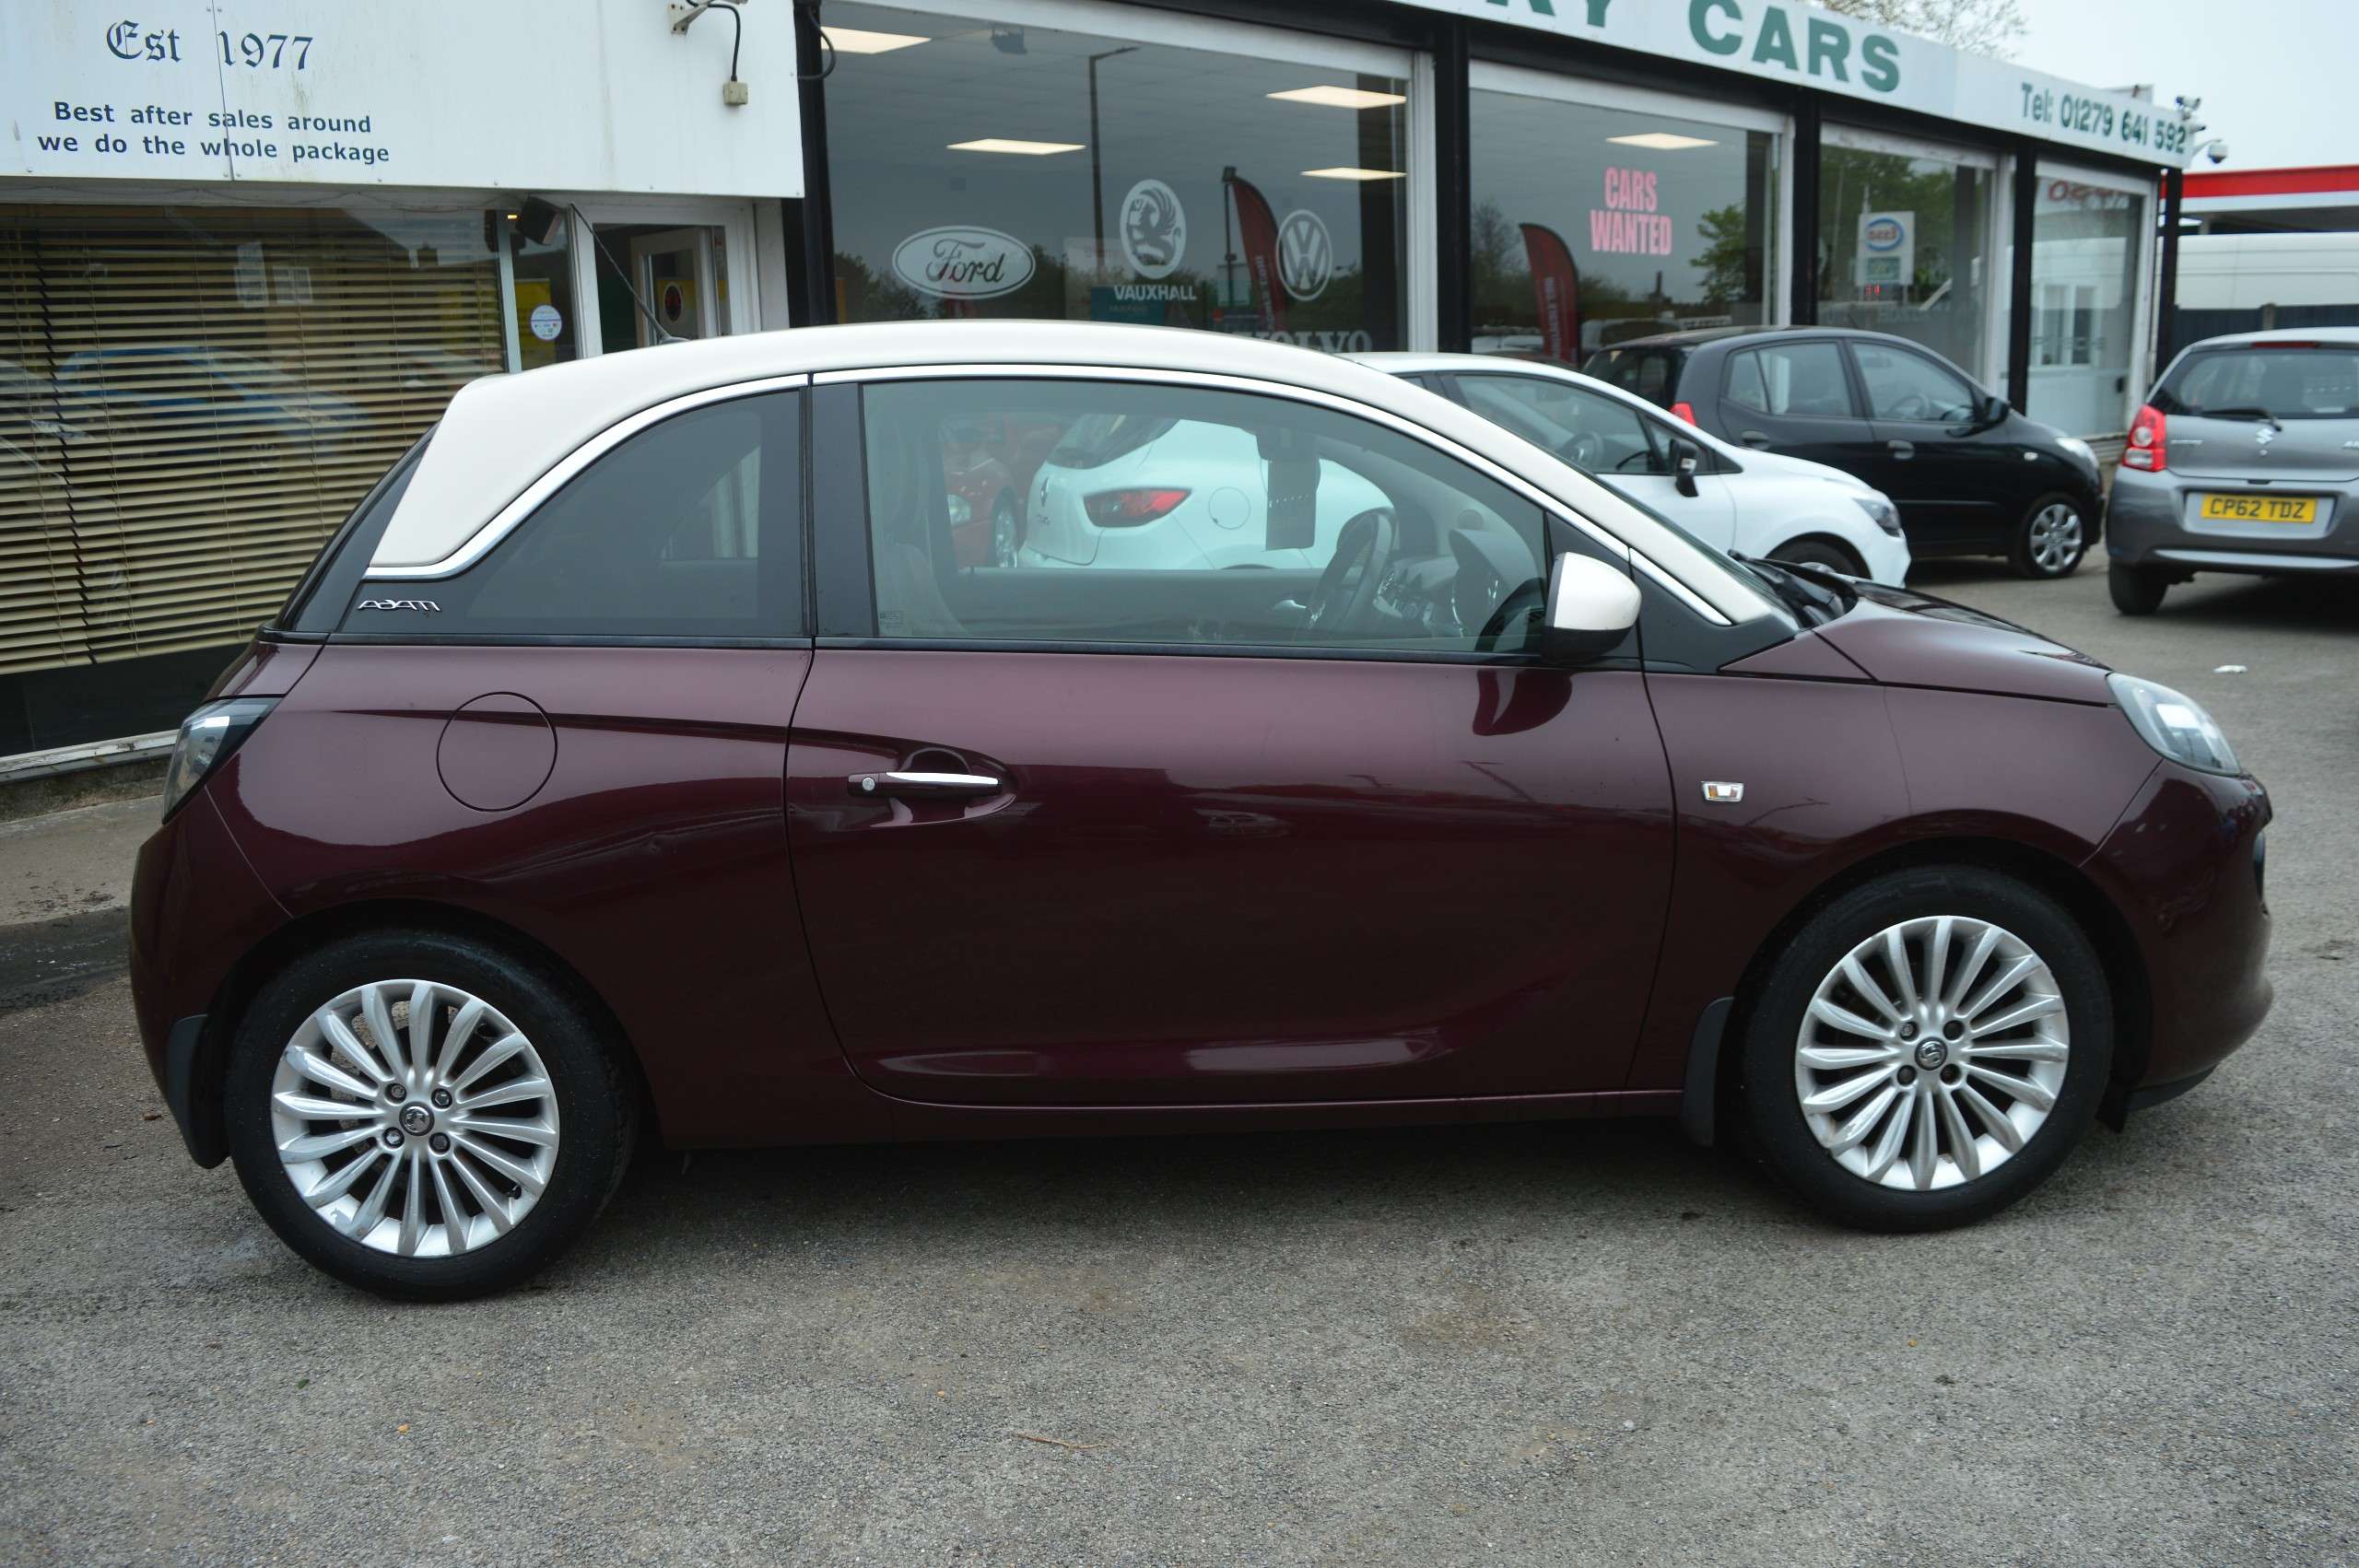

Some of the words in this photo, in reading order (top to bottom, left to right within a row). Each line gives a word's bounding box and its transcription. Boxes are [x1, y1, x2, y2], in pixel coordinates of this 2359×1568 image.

[106, 19, 182, 63] Est
[217, 30, 313, 70] 1977
[1689, 0, 1900, 93] CARS
[53, 101, 114, 123] Best
[130, 104, 193, 126] after
[208, 107, 273, 130] sales
[288, 113, 371, 134] around
[2022, 82, 2053, 123] Tel:
[2060, 94, 2113, 136] 01279
[2121, 110, 2149, 146] 641
[2154, 120, 2187, 154] 592
[38, 135, 78, 152] we
[95, 133, 128, 155] do
[143, 135, 185, 156] the
[200, 137, 277, 159] whole
[293, 142, 390, 165] package
[1605, 167, 1658, 212] CARS
[1590, 209, 1672, 255] WANTED
[925, 238, 1006, 283] Ford
[1114, 285, 1197, 301] VAUXHALL
[2211, 497, 2262, 518] CP62
[2269, 500, 2306, 519] TDZ
